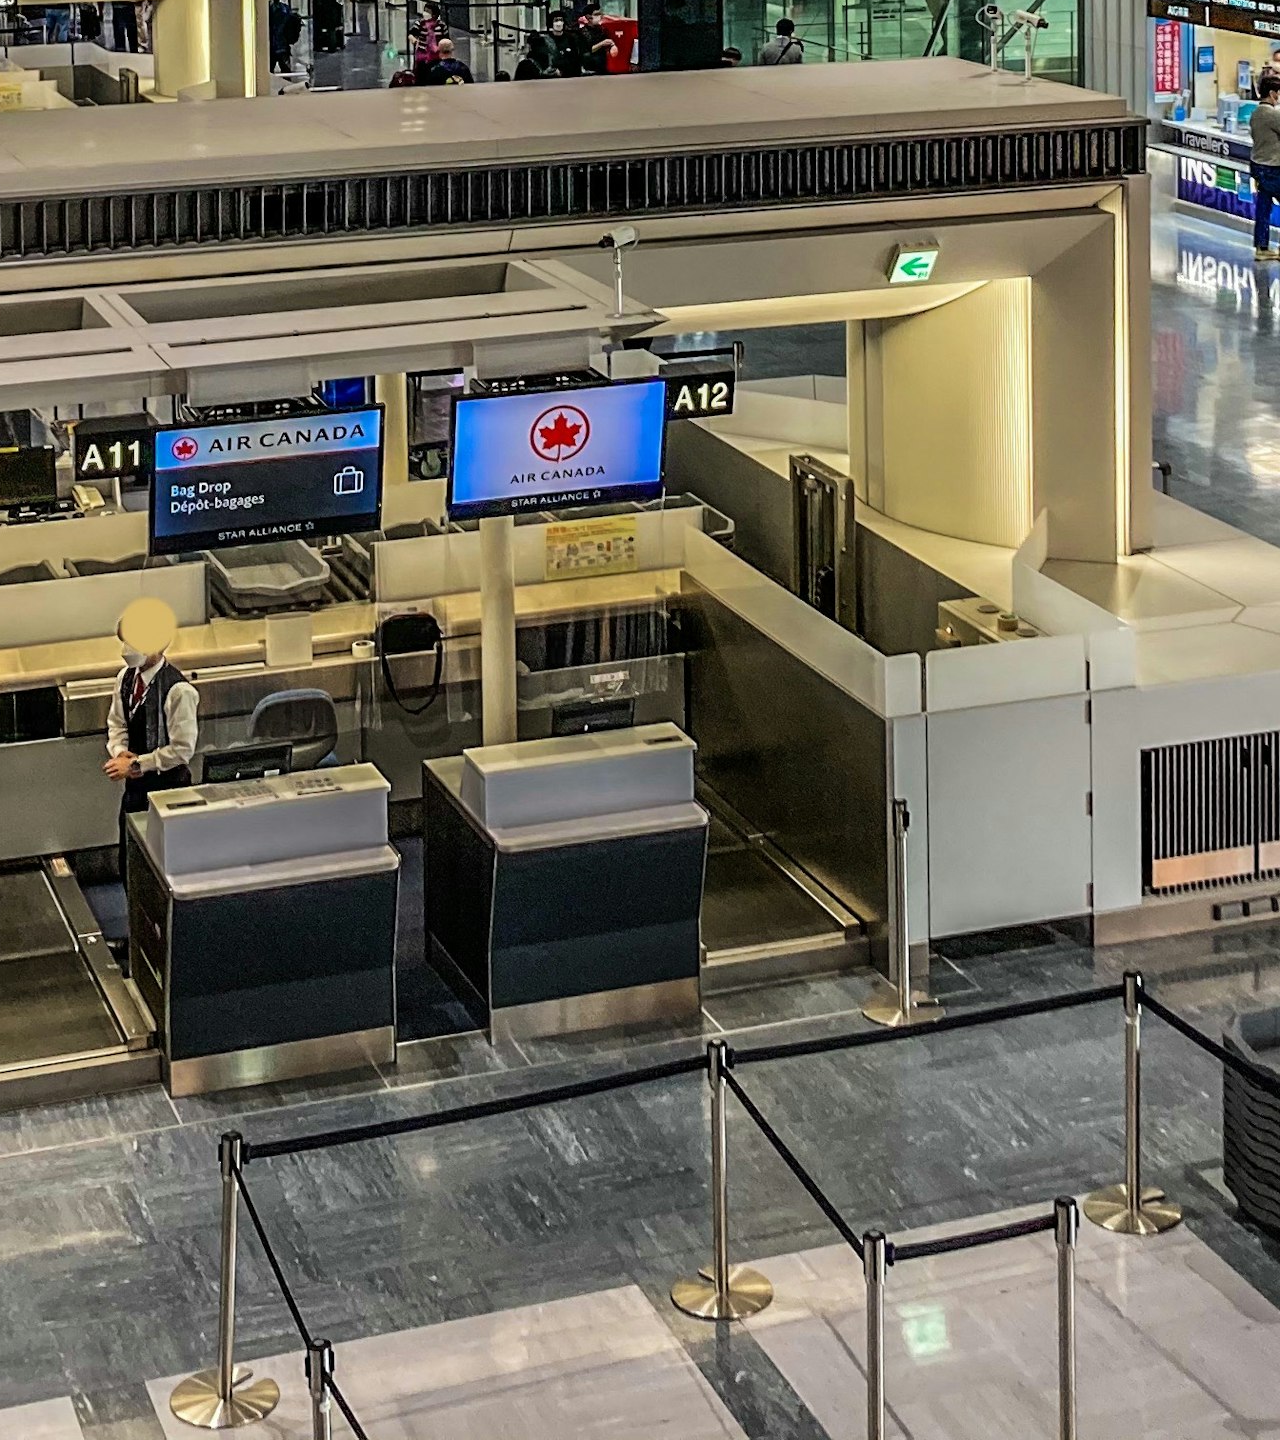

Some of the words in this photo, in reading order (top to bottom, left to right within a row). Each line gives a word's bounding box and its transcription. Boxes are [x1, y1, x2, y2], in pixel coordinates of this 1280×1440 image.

[1181, 131, 1230, 156] Traveller's
[673, 382, 728, 411] A12
[209, 435, 252, 453] AIR
[259, 424, 365, 449] CANADA
[81, 440, 141, 472] A11
[510, 472, 537, 485] AIR
[541, 465, 606, 482] CANADA
[170, 484, 196, 500] Bag
[198, 480, 232, 497] Drop
[511, 496, 538, 508] STAR
[540, 490, 590, 505] ALLIANCE
[170, 492, 265, 516] Dépôt-bagages
[218, 530, 246, 542] STAR
[248, 522, 302, 538] ALLIANCE
